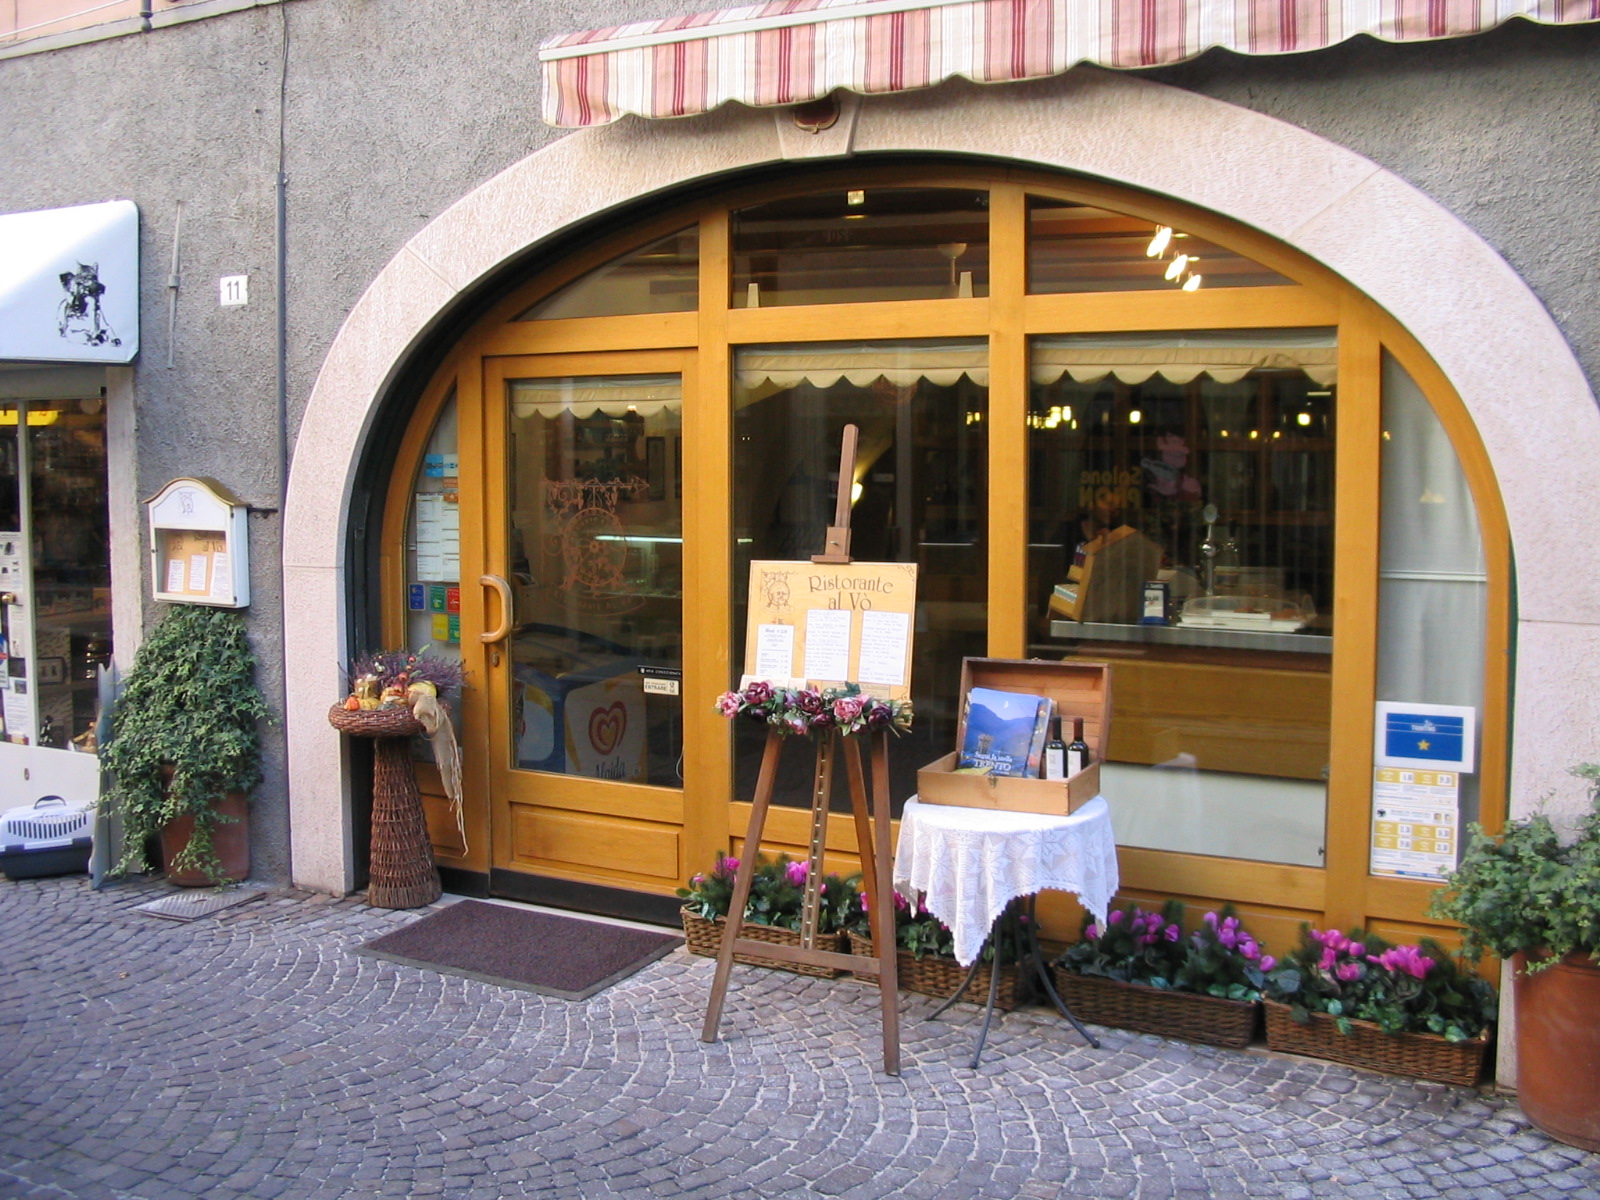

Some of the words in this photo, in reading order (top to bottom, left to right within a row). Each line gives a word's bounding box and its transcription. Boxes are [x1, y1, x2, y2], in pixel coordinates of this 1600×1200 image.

[226, 280, 240, 301] 11
[808, 574, 894, 595] Ristorante
[828, 591, 842, 611] al
[848, 591, 872, 612] Vò
[974, 758, 1012, 772] TRENTO
